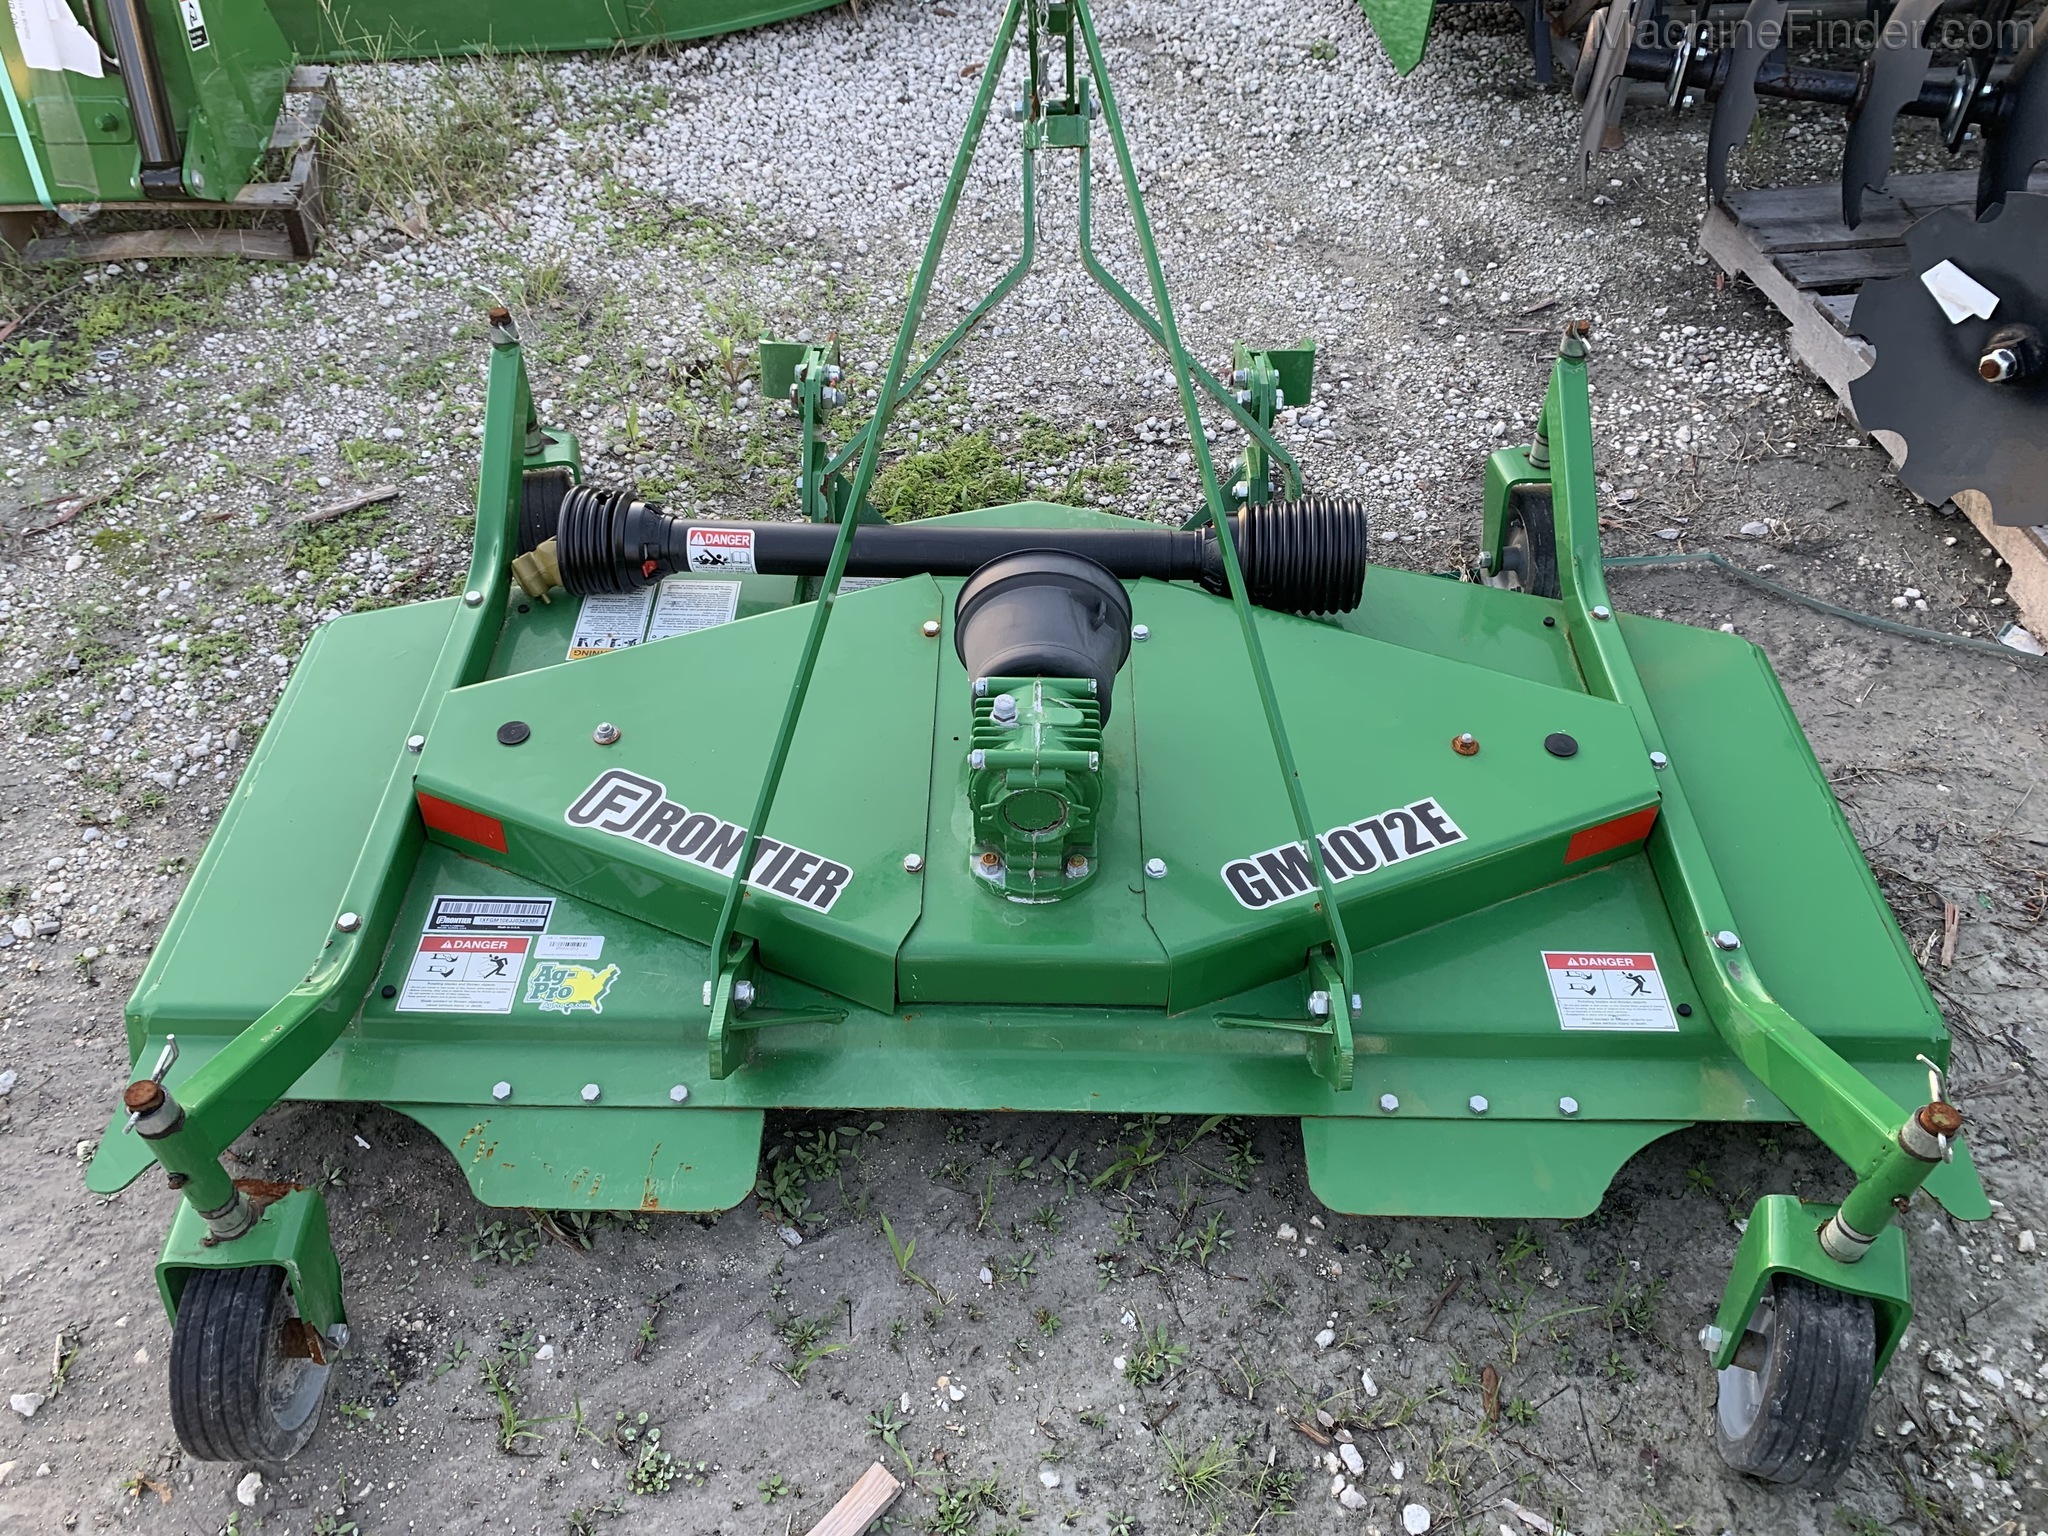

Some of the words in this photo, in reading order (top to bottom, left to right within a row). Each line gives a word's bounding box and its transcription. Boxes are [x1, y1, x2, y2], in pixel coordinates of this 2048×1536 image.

[705, 533, 750, 546] DANGER
[568, 770, 850, 909] FRONTIER
[1225, 801, 1461, 907] GM1072E
[453, 940, 508, 949] DANGER
[1578, 957, 1635, 967] DANGER
[534, 965, 576, 986] Ag-
[529, 983, 573, 1000] Pro
